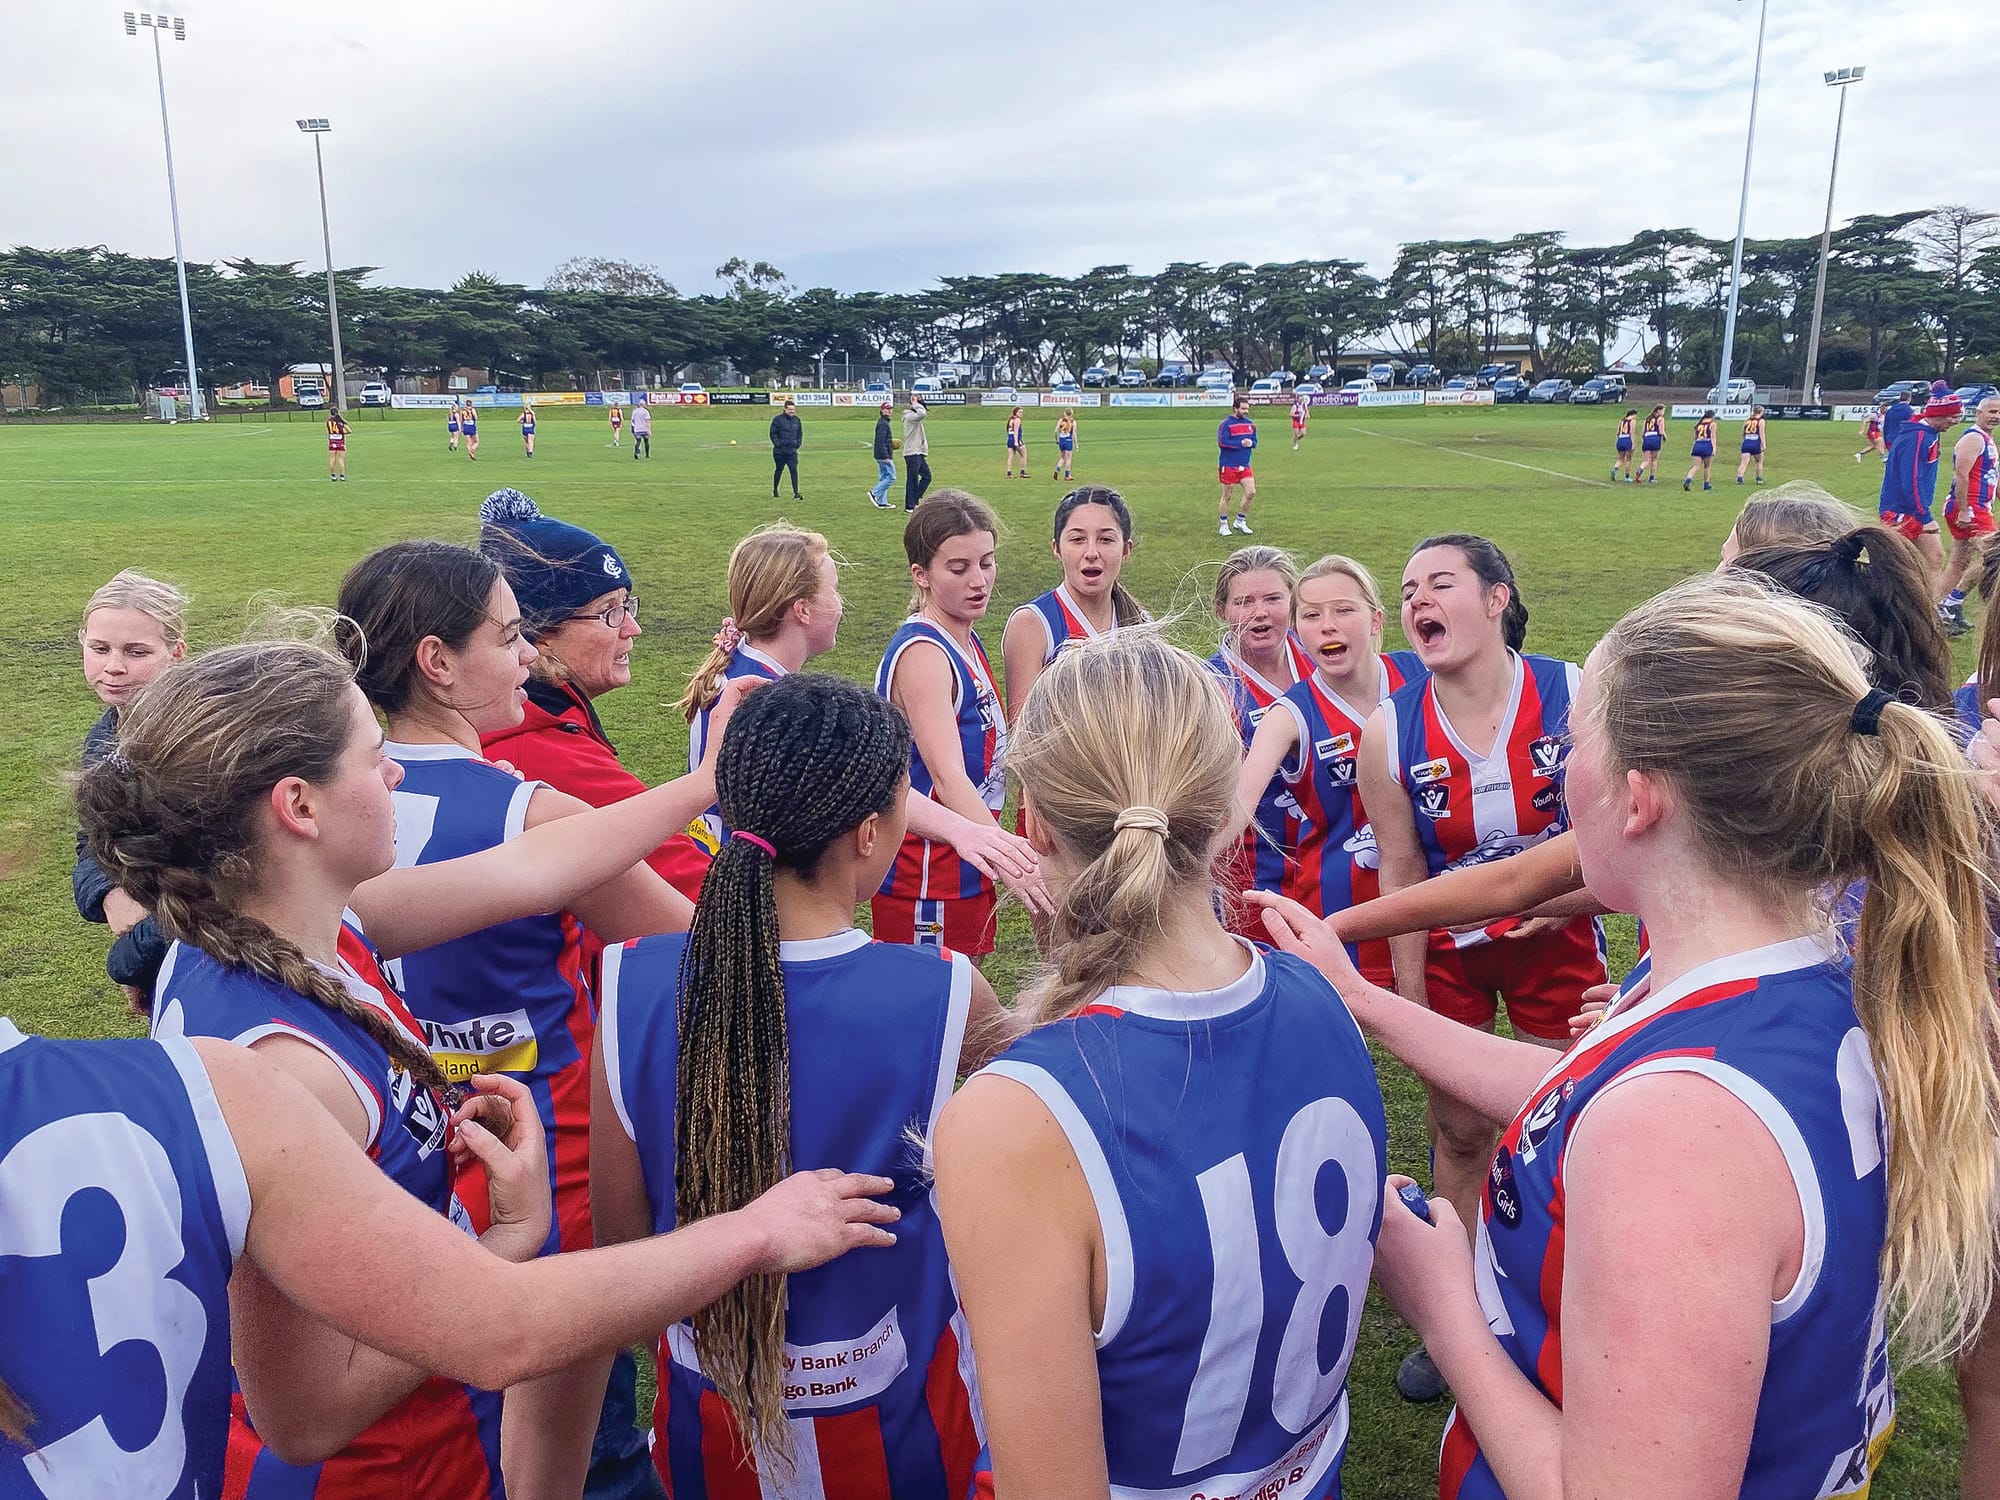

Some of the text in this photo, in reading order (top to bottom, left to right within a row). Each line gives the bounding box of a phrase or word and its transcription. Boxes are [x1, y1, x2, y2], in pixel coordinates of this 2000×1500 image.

[328, 420, 340, 434] 14
[1533, 791, 1554, 808] Youth
[440, 1060, 480, 1075] land
[1497, 1190, 1517, 1220] Girls
[1172, 1097, 1378, 1476] 18
[0, 1112, 208, 1500] 3
[801, 1353, 849, 1371] Bank
[853, 1324, 894, 1363] Branch
[810, 1376, 858, 1397] Bank
